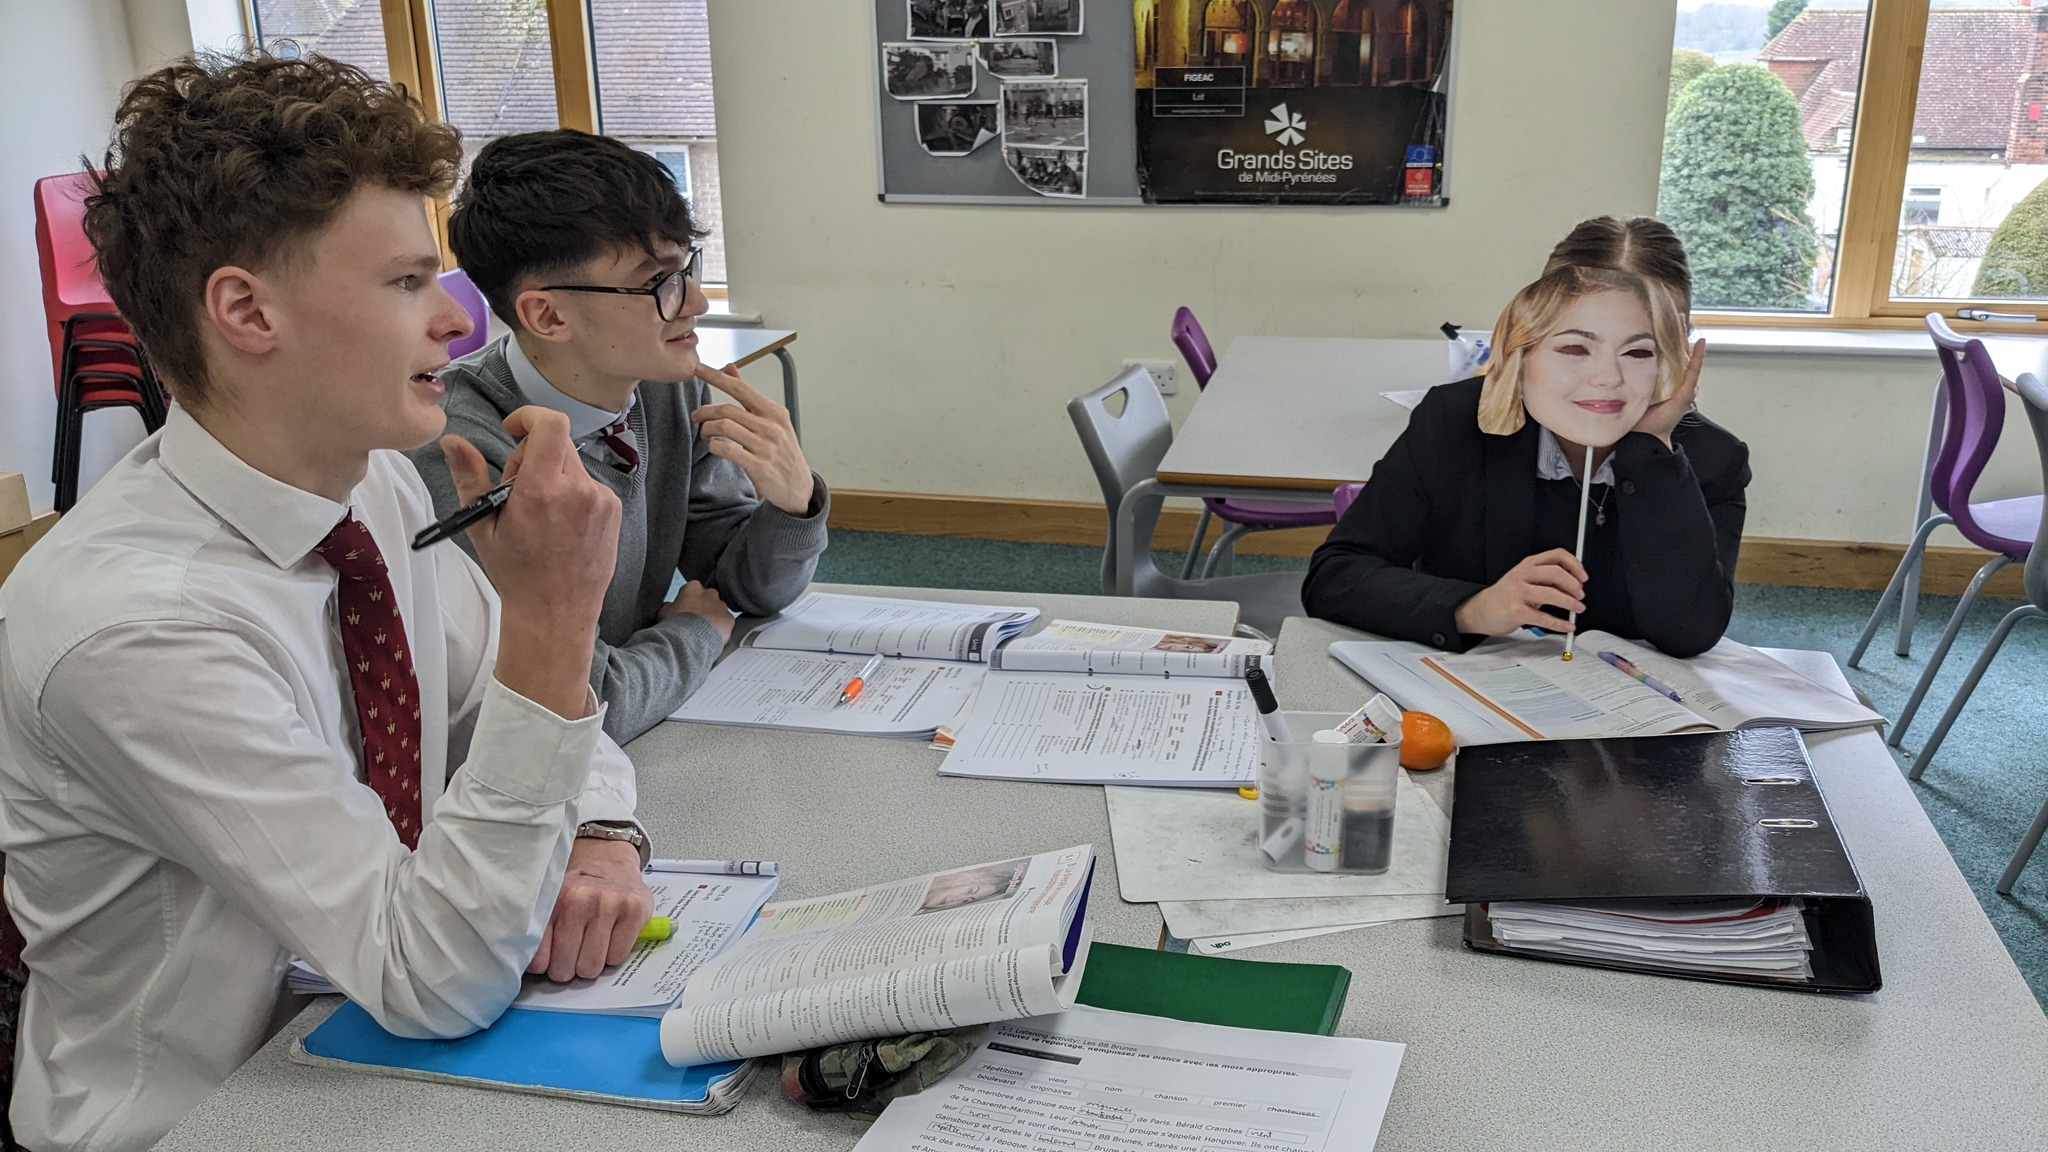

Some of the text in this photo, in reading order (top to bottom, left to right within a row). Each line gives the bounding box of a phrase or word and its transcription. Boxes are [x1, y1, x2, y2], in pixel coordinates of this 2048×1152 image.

[1217, 149, 1353, 170] Grands Sites
[1238, 172, 1337, 185] de Midi-Pyrénées
[1015, 1027, 1049, 1039] Listening
[1050, 1034, 1080, 1044] activity:
[1083, 1039, 1096, 1047] Les
[1111, 1043, 1138, 1051] Brunes
[982, 1064, 1024, 1077] répétitions
[977, 1073, 1016, 1086] boulevard
[1048, 1076, 1068, 1084] vient
[1030, 1084, 1072, 1096] originaires
[1153, 1093, 1188, 1102] chanson
[957, 1084, 1076, 1112] Trois membres du groupe sont
[1213, 1100, 1247, 1109] premier
[942, 1103, 958, 1111] leur
[971, 1098, 1046, 1118] Charente-Maritime.
[1049, 1113, 1069, 1122] Leur
[935, 1113, 980, 1128] Gainsbourg
[991, 1124, 1022, 1137] d'après
[1150, 1118, 1172, 1126] Paris.
[1175, 1121, 1203, 1130] Bérald
[1205, 1124, 1243, 1134] Crambes
[1027, 1120, 1046, 1129] sont
[1047, 1124, 1083, 1136] devenus
[1084, 1131, 1096, 1139] les
[1112, 1136, 1144, 1147] Brunes,
[1147, 1141, 1178, 1150] d'après
[1129, 1127, 1159, 1136] groupe
[1161, 1132, 1202, 1142] s'appelait
[1204, 1136, 1247, 1147] Hangover.
[919, 1134, 984, 1152] rock des années
[992, 1136, 1029, 1150] l'époque.
